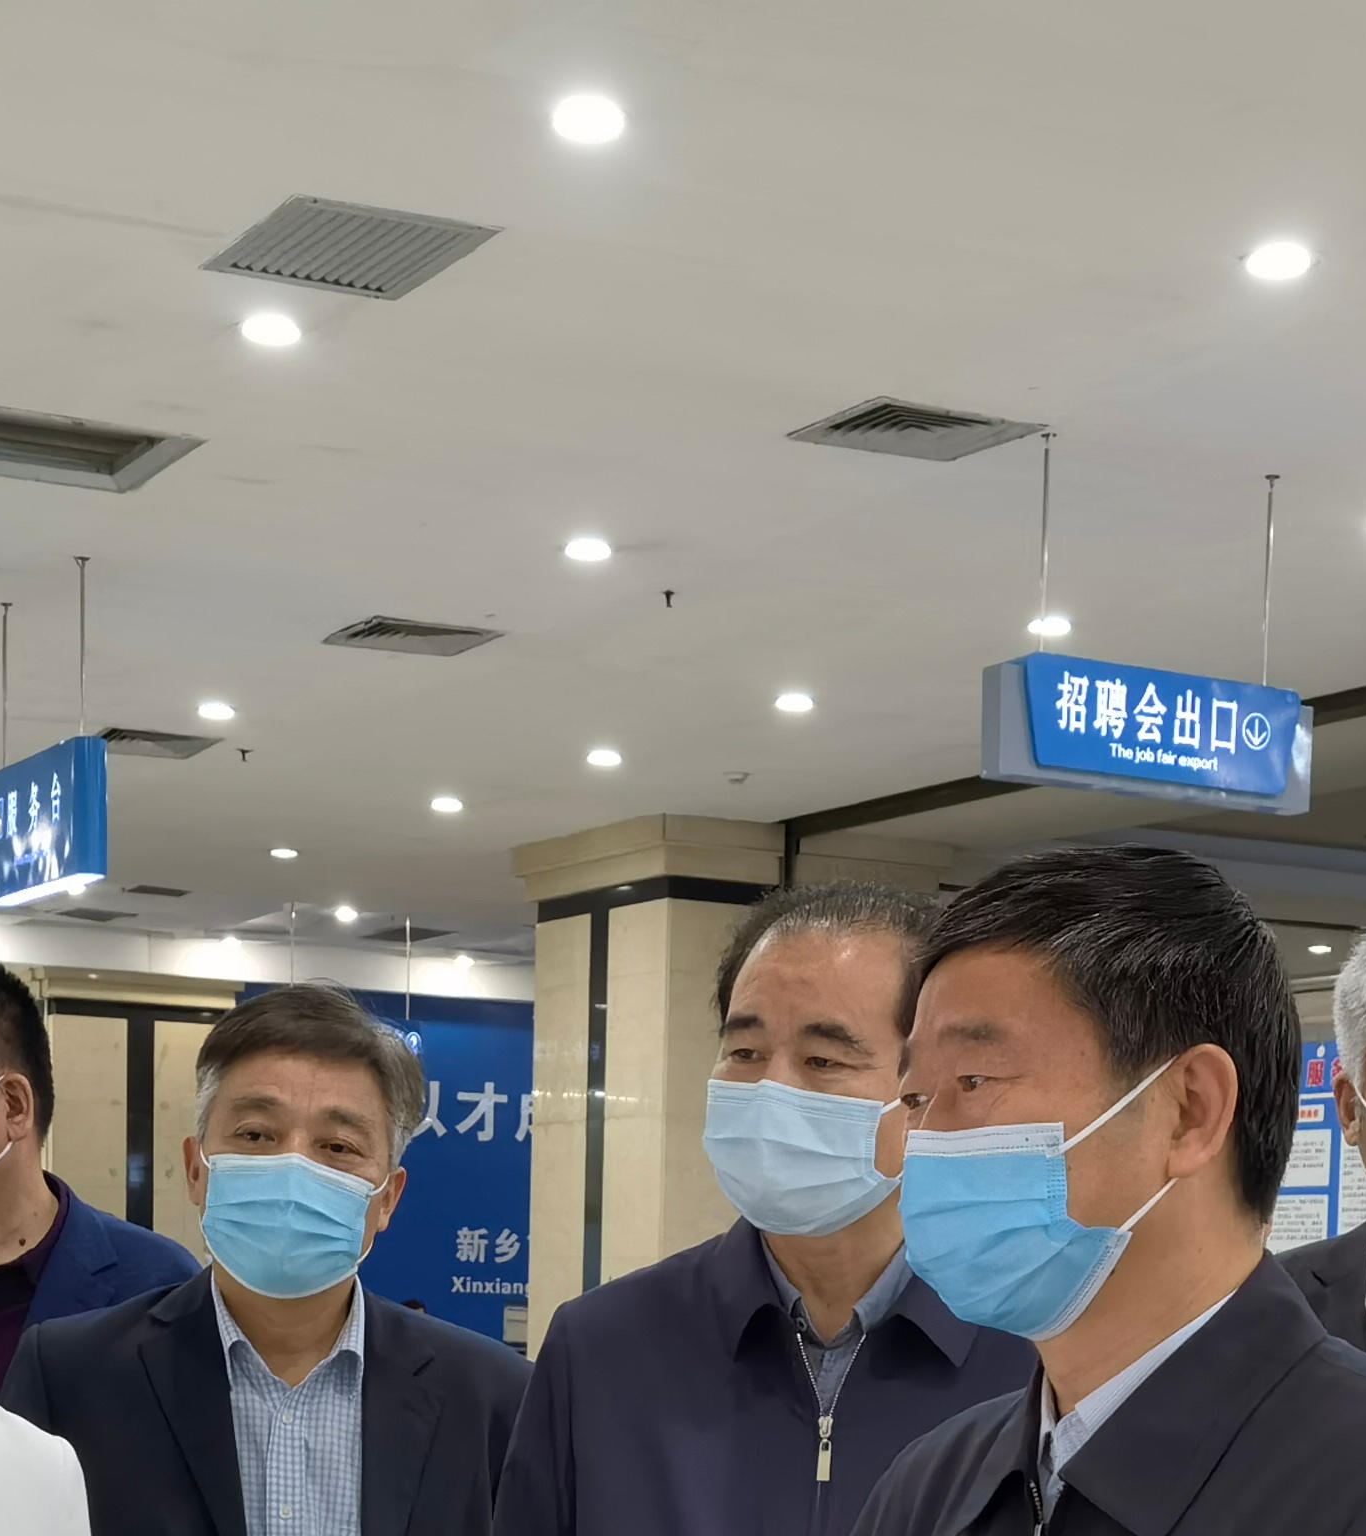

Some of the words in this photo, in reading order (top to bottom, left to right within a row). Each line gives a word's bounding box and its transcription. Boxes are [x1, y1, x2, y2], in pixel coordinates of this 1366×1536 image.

[1055, 670, 1238, 754] 招聘会出口
[1109, 742, 1134, 760] The
[1134, 745, 1155, 764] job
[1156, 749, 1178, 766] fair
[1178, 755, 1218, 773] export
[455, 1226, 530, 1264] 新乡
